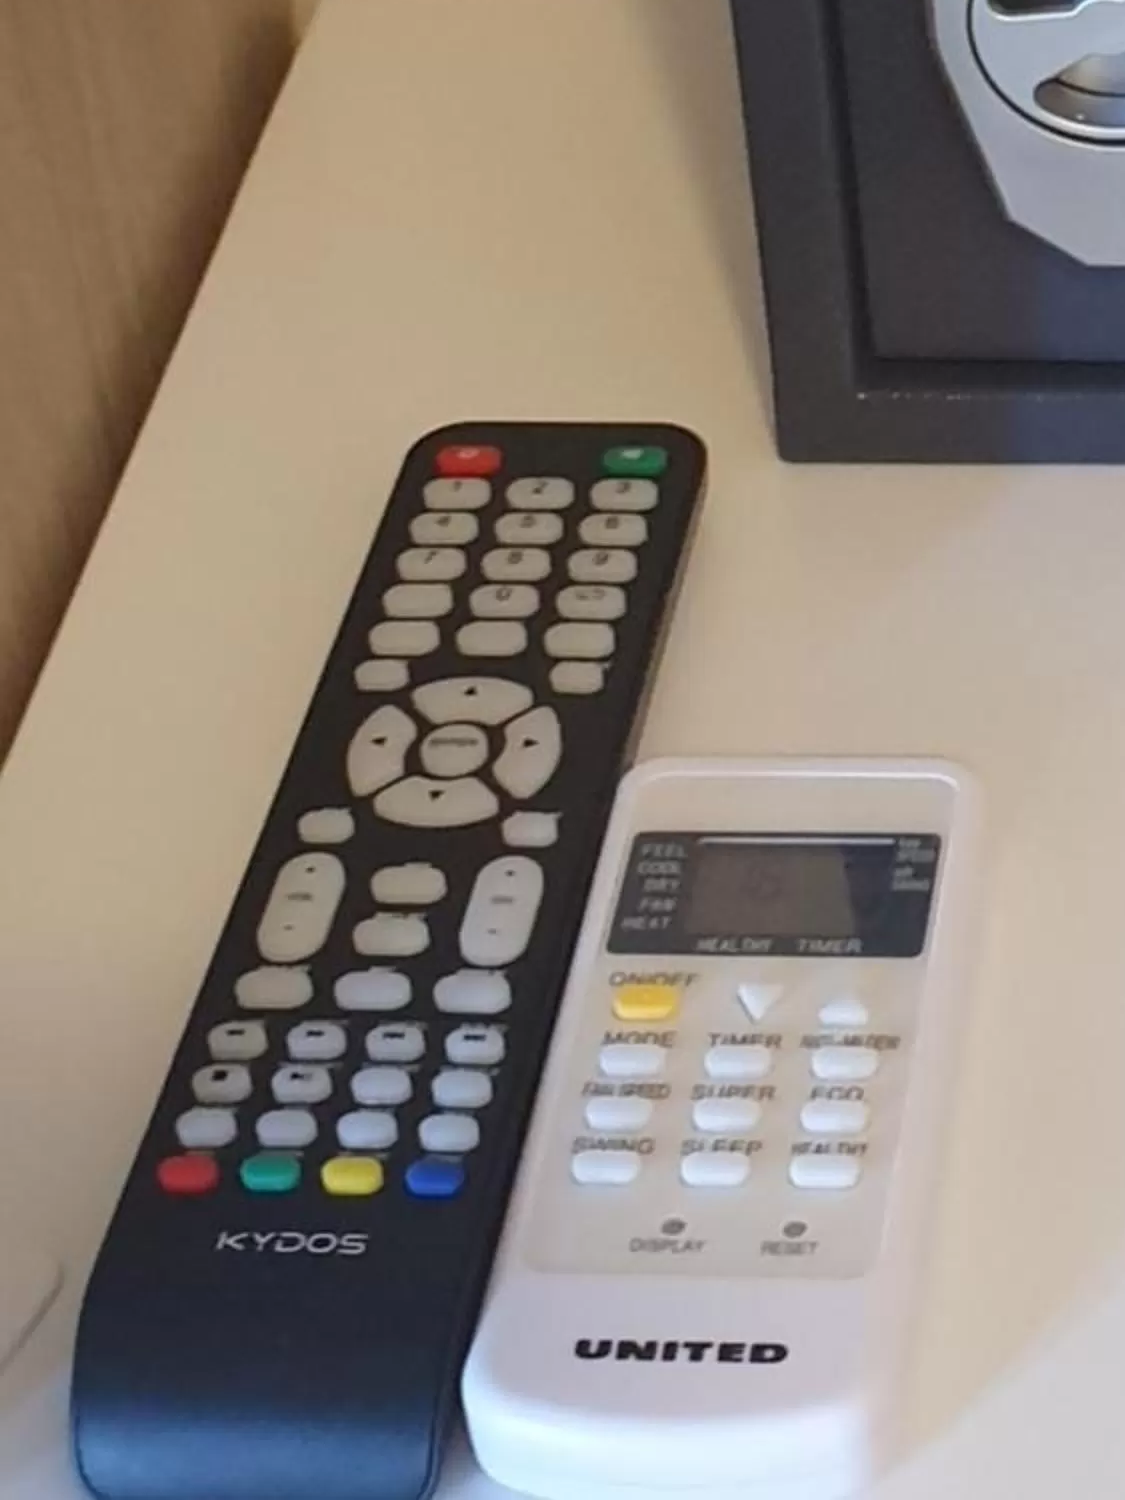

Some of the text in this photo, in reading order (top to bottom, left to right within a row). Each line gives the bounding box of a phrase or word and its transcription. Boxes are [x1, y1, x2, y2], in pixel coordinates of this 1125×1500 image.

[796, 937, 863, 953] TIMER
[601, 1030, 678, 1048] MODE
[708, 1031, 783, 1048] TIMER
[691, 1083, 777, 1101] SUPER
[216, 1231, 370, 1256] KYDOS
[629, 1237, 819, 1256] DISPLAY RESET
[574, 1338, 790, 1364] UNITED
